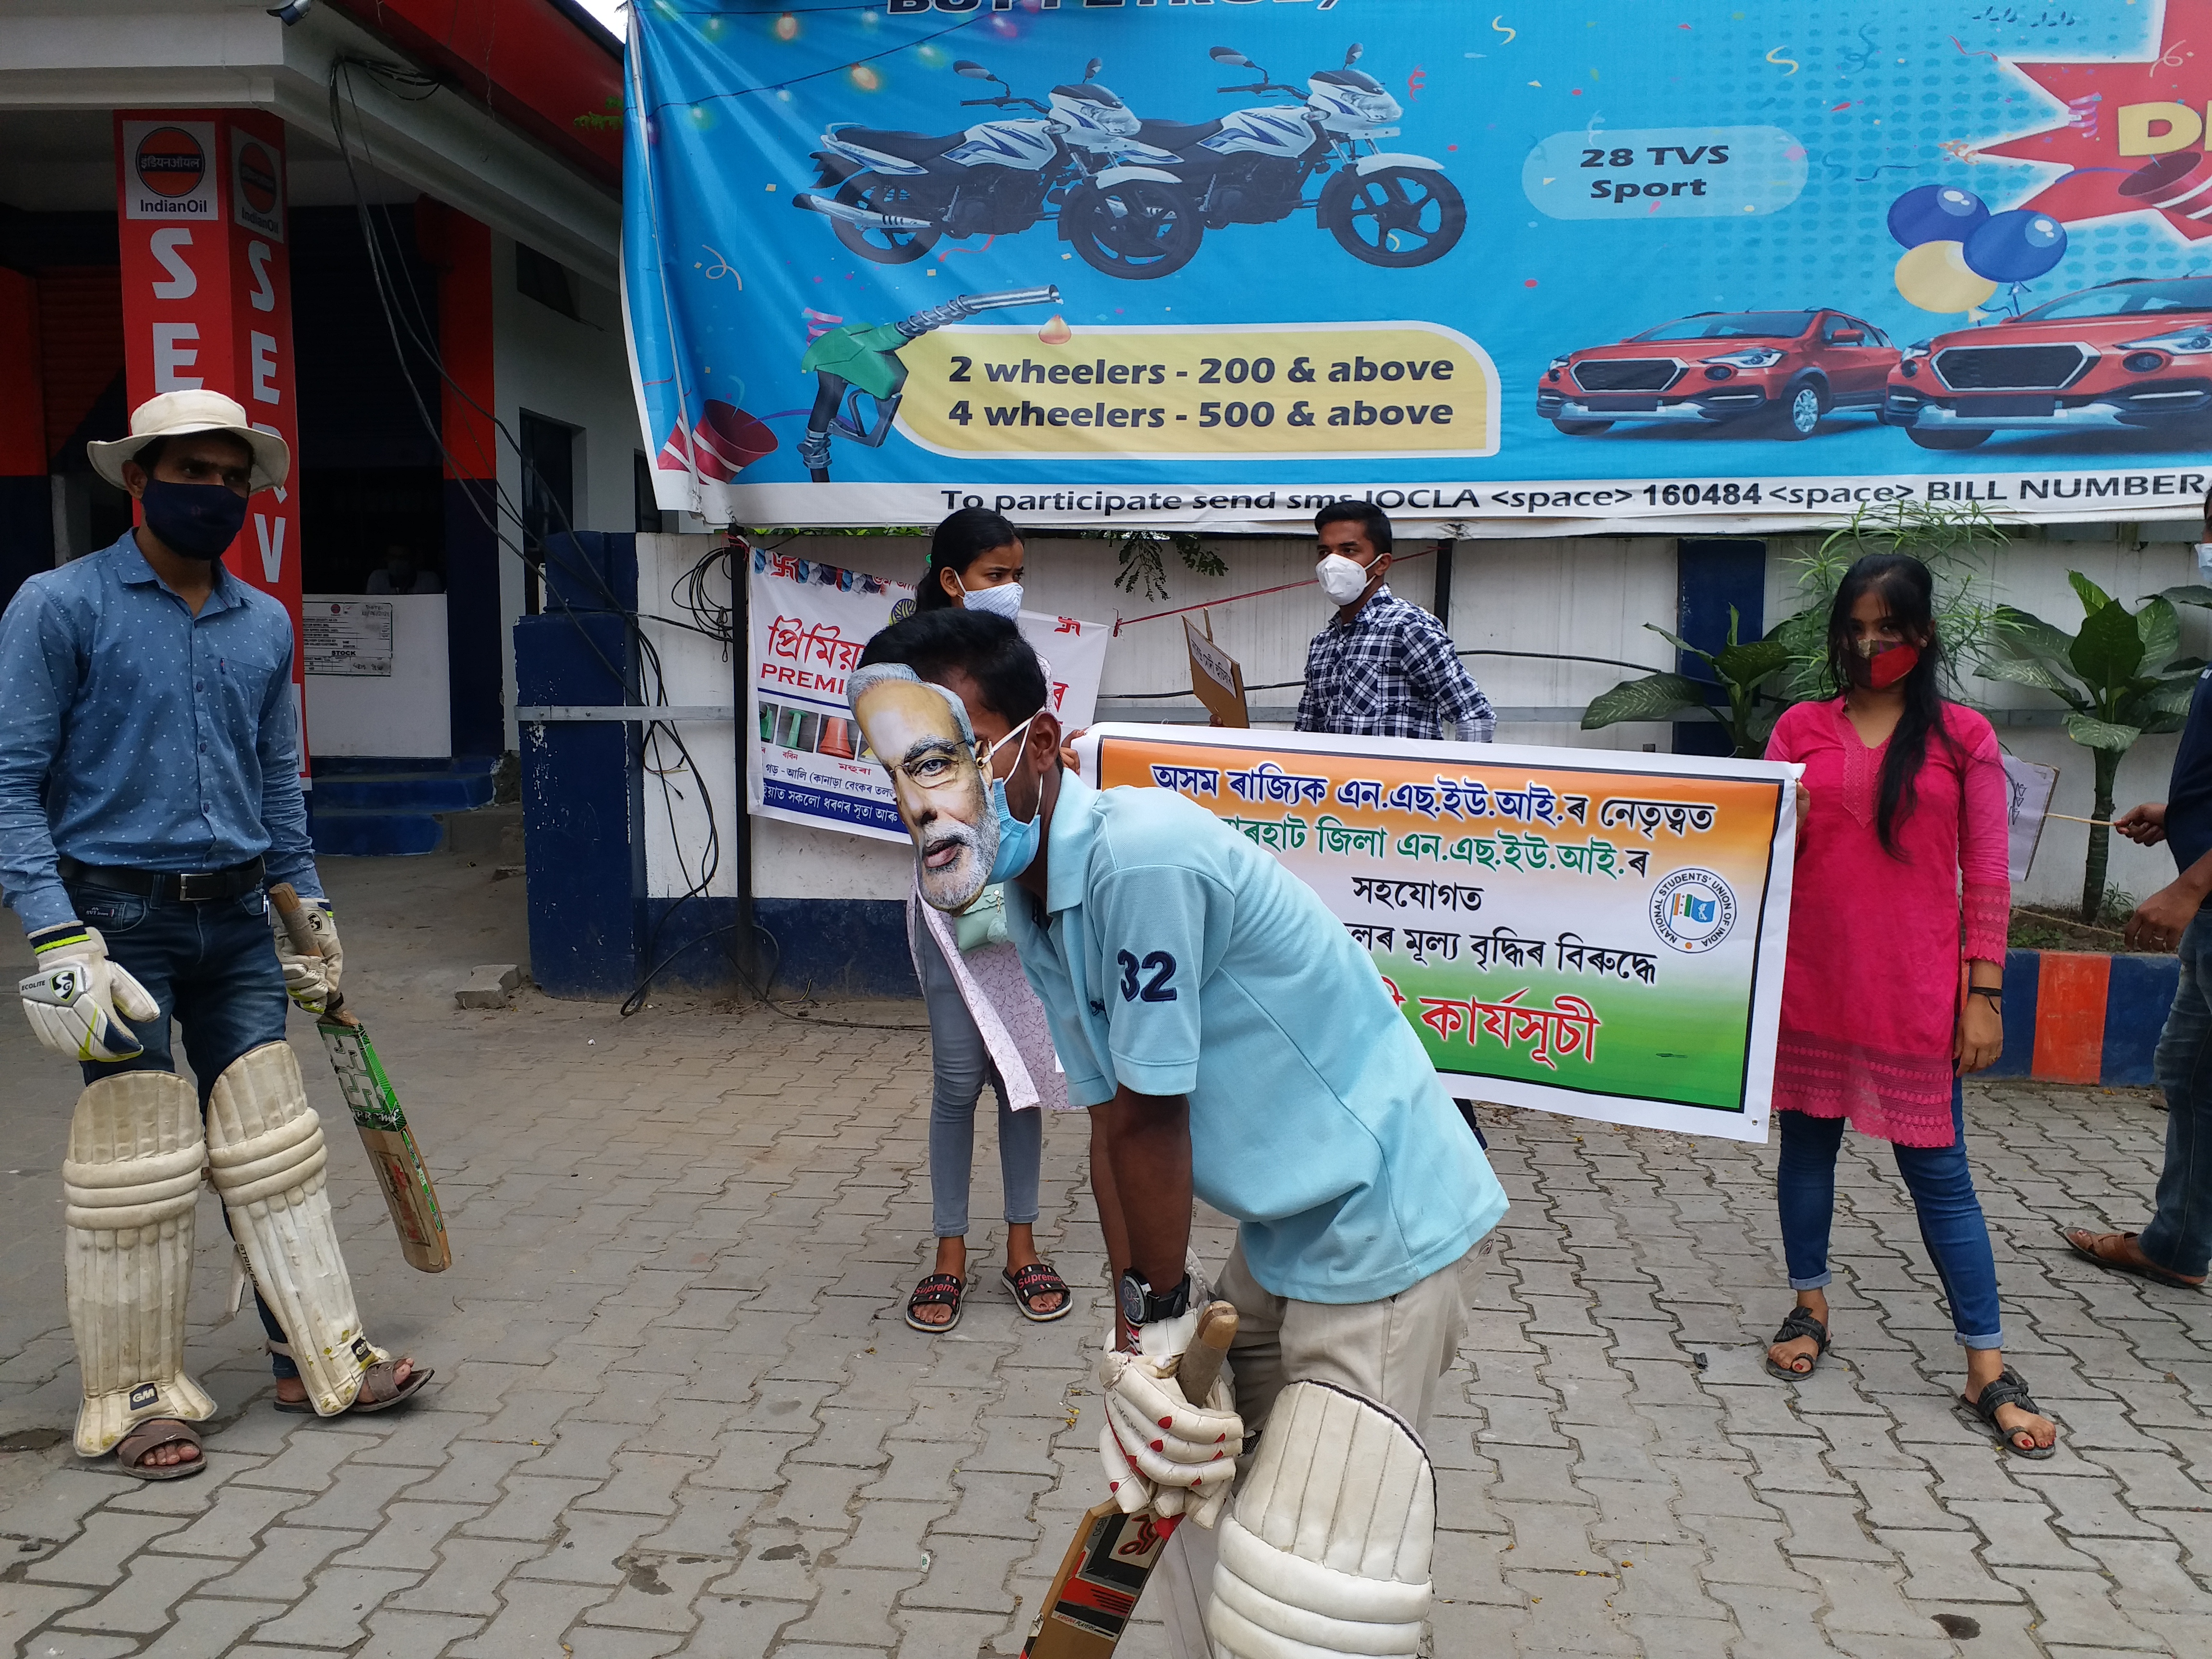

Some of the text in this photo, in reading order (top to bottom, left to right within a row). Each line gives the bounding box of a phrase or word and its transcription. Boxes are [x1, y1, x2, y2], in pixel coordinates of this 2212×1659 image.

[141, 156, 200, 168] इंडियनऑयल
[1580, 145, 1729, 168] 28 TVS
[1590, 178, 1707, 203] Sport
[140, 199, 207, 213] IndianOil
[242, 207, 279, 234] IndianOil
[950, 356, 972, 383] 2
[984, 359, 1166, 385] wheelers
[1198, 358, 1274, 384] 200
[1288, 357, 1316, 383] &
[1328, 356, 1454, 383] above
[949, 401, 973, 426] 4
[984, 401, 1165, 427] wheelers
[1198, 401, 1274, 427] 500
[1287, 401, 1316, 427] &
[1328, 401, 1453, 426] above
[941, 490, 984, 509] To
[996, 490, 1180, 517] participate
[1192, 492, 1276, 510] send
[1366, 489, 1479, 508] IOCLA
[1491, 488, 1632, 513] <space>
[1643, 483, 1762, 506] 160484
[1769, 485, 1914, 509] <space>
[1927, 481, 2008, 502] BILL
[2020, 473, 2205, 500] NUMBER
[760, 662, 846, 696] PREMI
[1151, 766, 1220, 796] অসম
[1226, 763, 1329, 805] ৰাজ্যিক
[1316, 816, 1388, 858] জিলা
[1351, 876, 1484, 911] সহযোগত
[1711, 880, 1732, 910] UNION
[1654, 899, 1678, 944] NATIONAL
[1722, 913, 1731, 927] OF
[1701, 927, 1726, 948] INDIA
[1343, 922, 1659, 985] লৰ মূল্য বৃদ্ধিৰ বিৰুদ্ধে
[21, 980, 46, 991] ECOLITE
[53, 971, 75, 998] SG
[1117, 949, 1177, 1002] 32
[239, 1243, 259, 1287] STRIKER
[132, 1388, 155, 1403] GM
